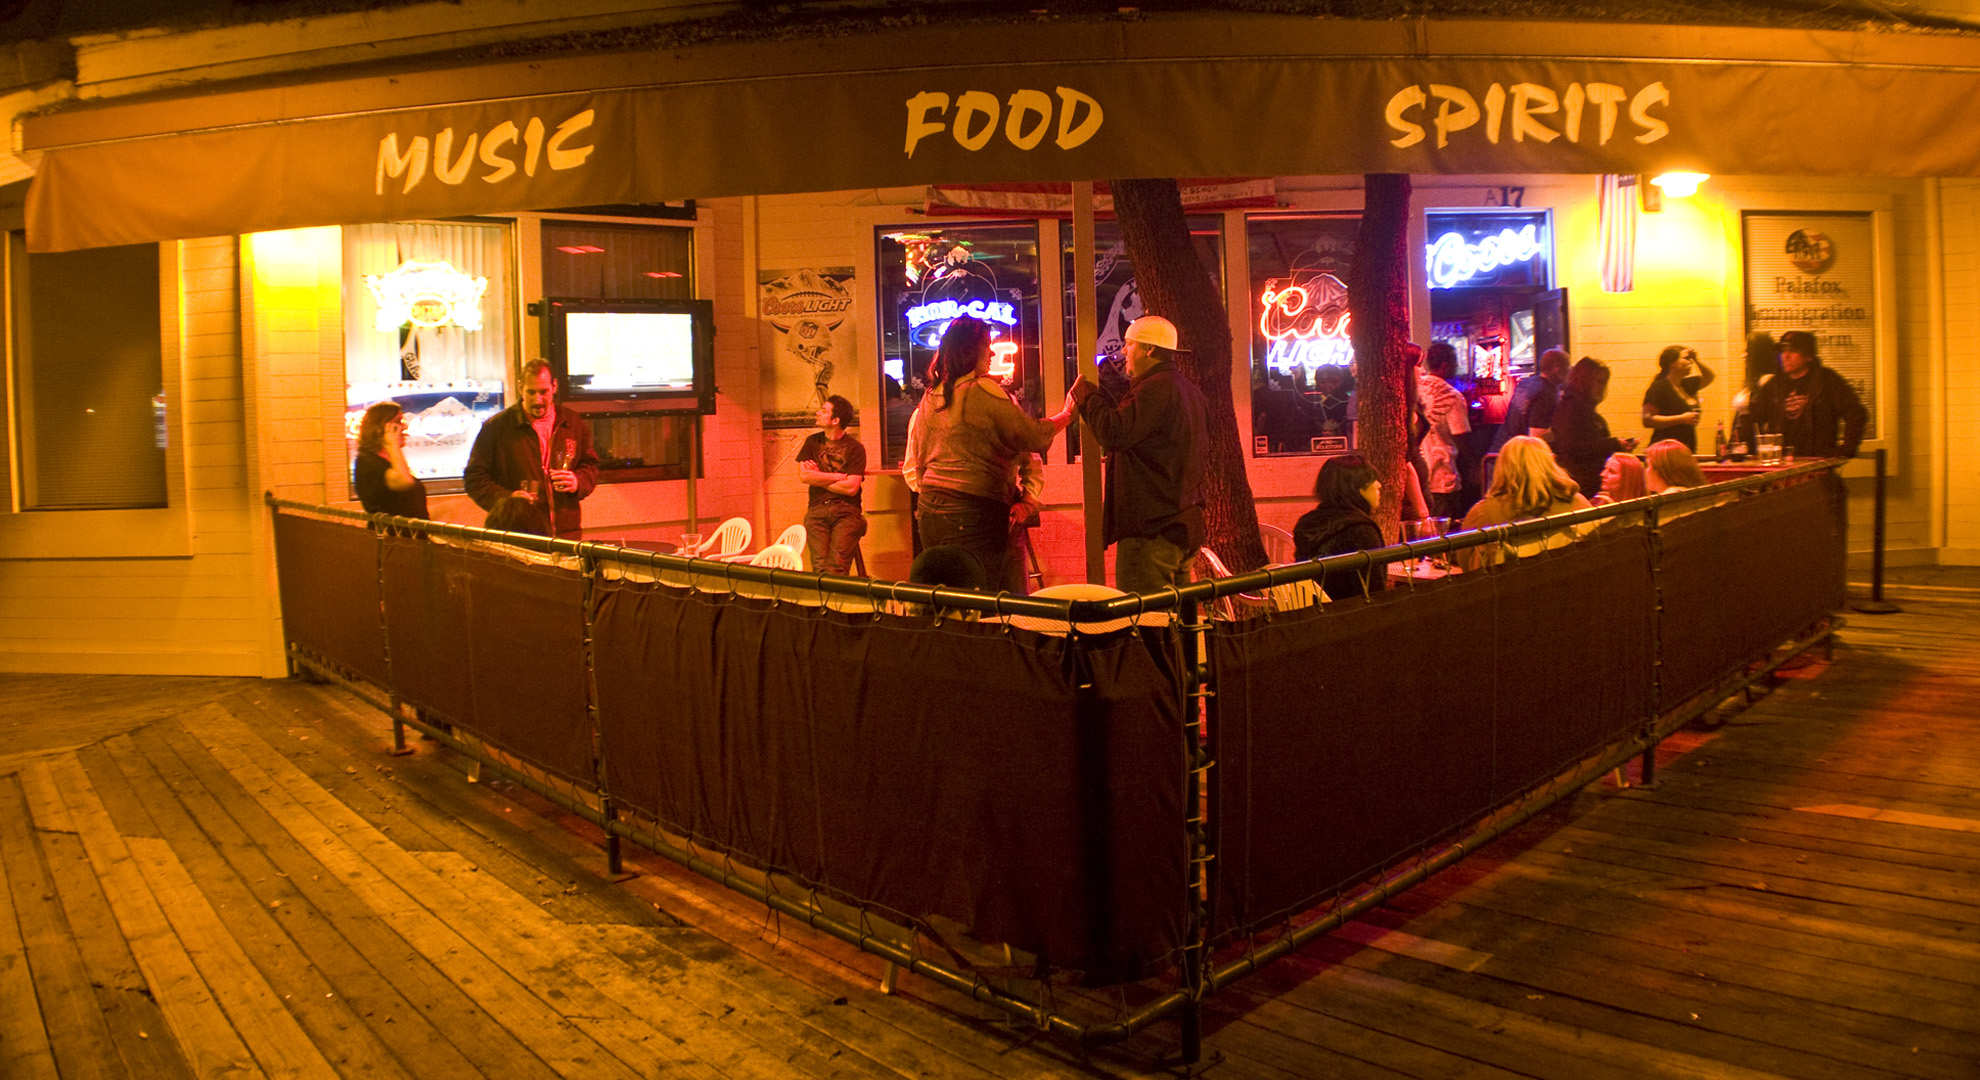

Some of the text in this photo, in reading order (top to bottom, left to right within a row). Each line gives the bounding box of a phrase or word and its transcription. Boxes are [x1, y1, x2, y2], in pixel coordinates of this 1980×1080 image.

[375, 81, 1670, 196] MUSIC FOOD SPIRITS
[1775, 276, 1843, 295] Palafox
[763, 295, 852, 316] Coors LIGHT
[1752, 303, 1866, 325] Immigration
